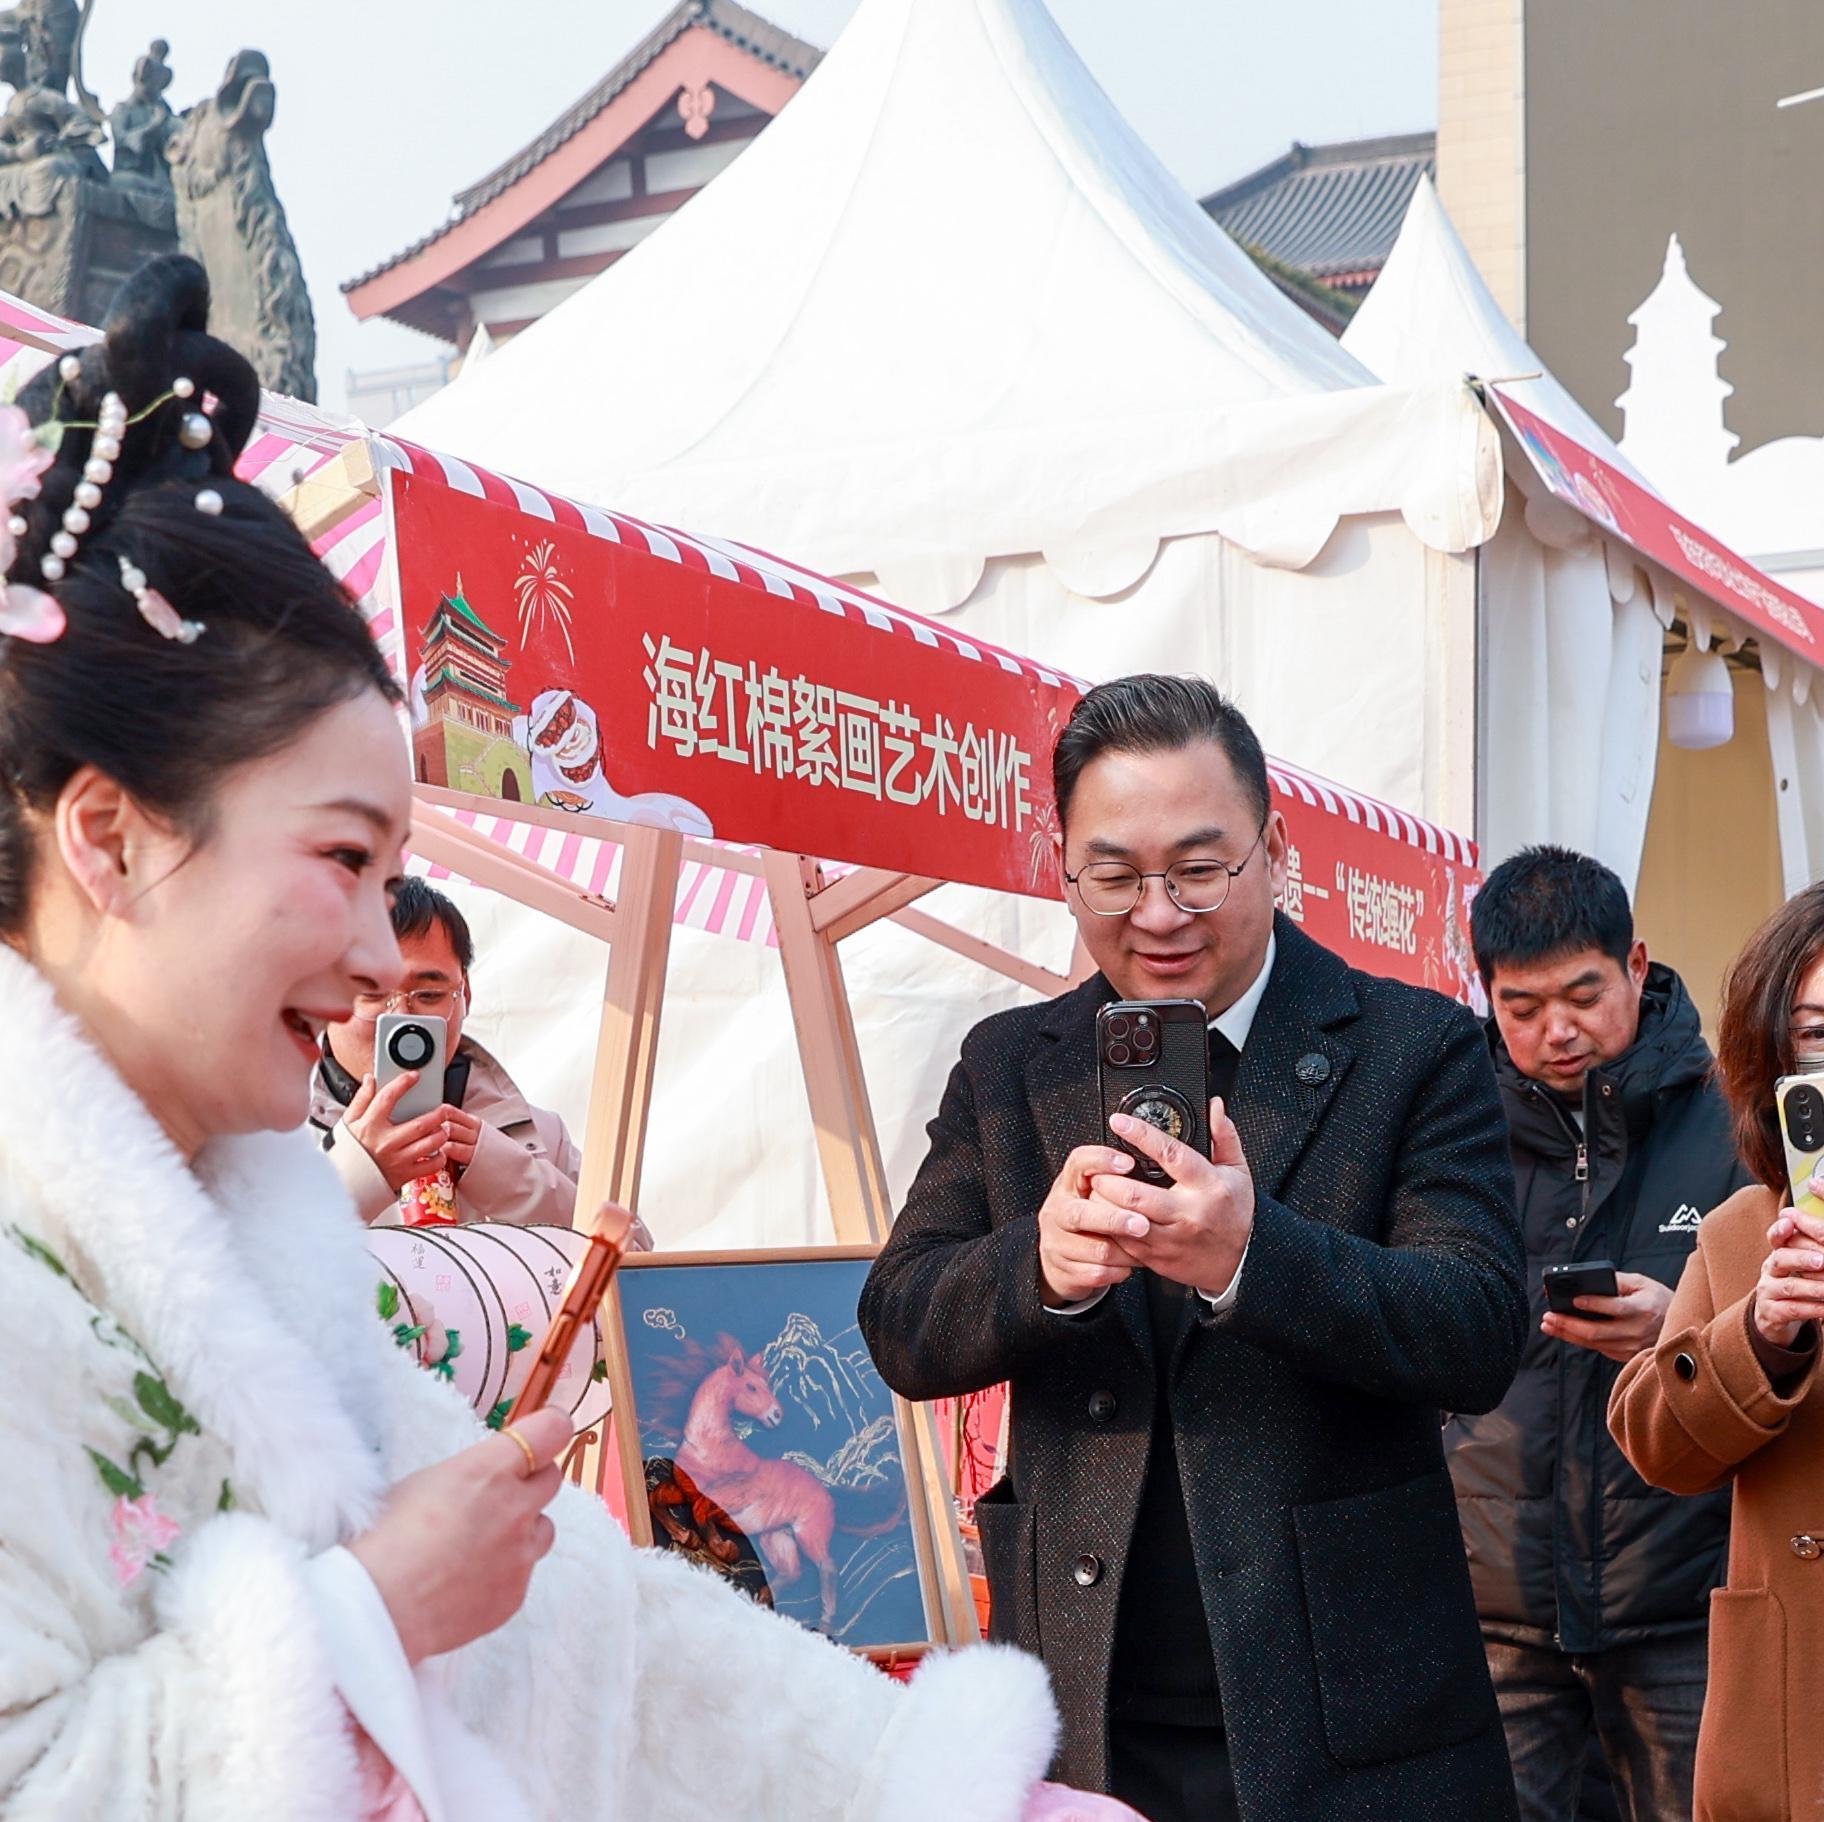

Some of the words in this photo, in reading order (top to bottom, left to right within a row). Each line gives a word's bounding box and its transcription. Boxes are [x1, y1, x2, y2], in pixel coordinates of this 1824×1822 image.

[642, 631, 1032, 832] 海红棉絮画艺术创作
